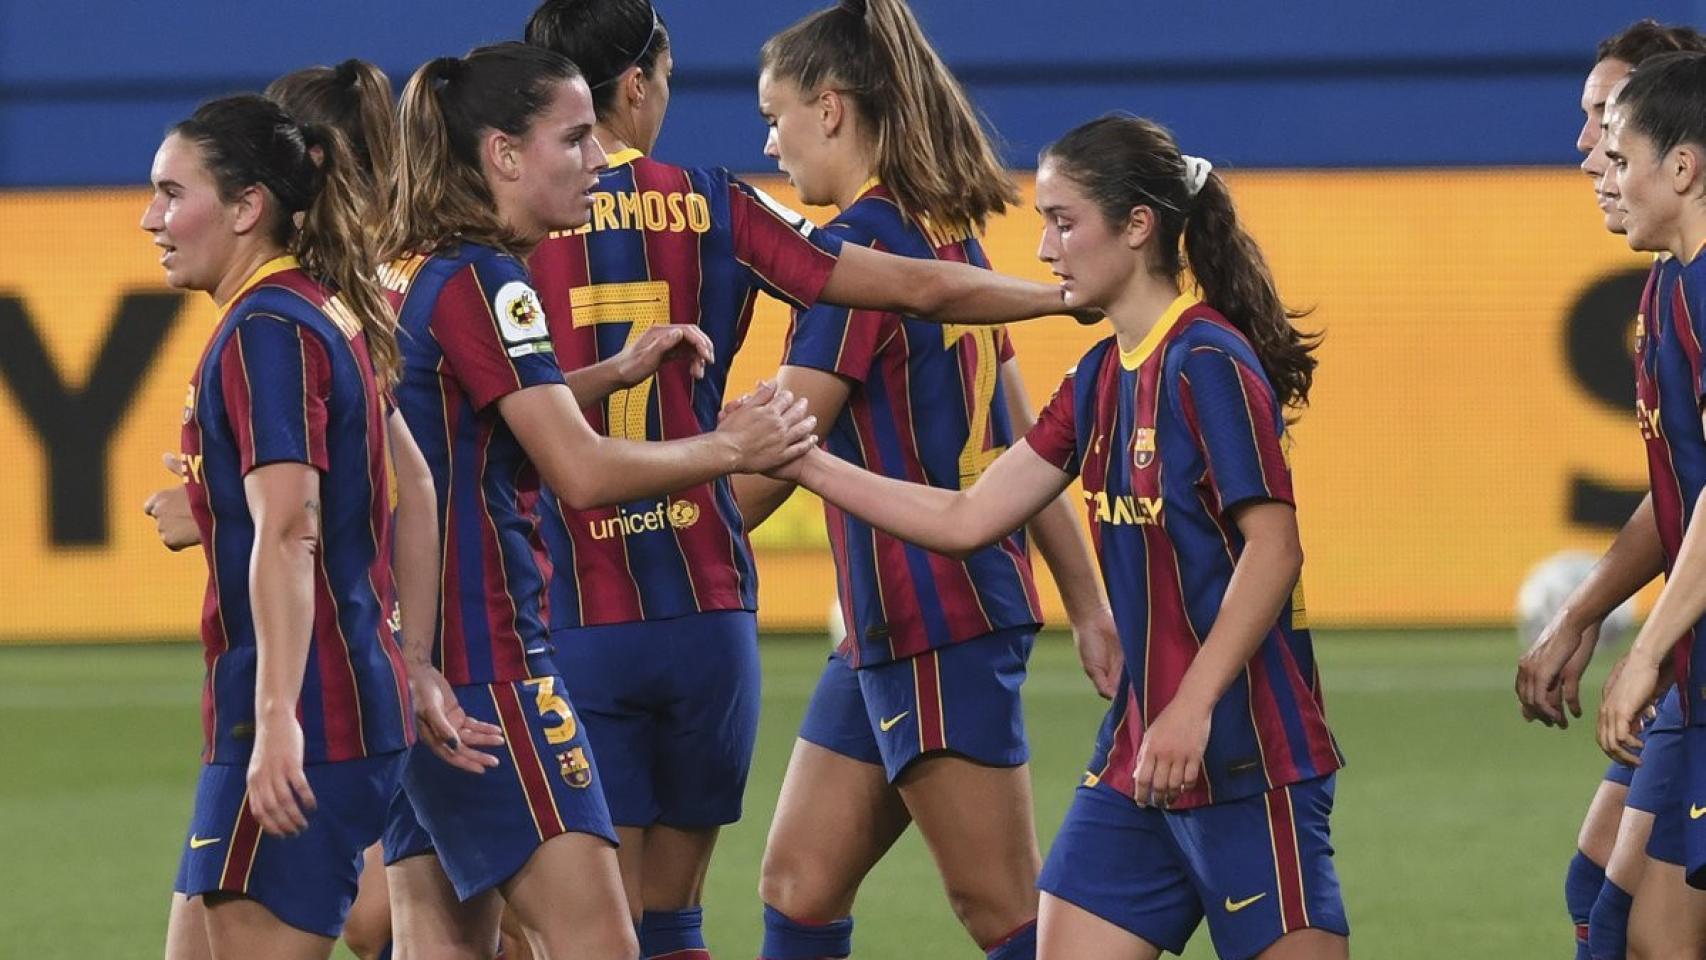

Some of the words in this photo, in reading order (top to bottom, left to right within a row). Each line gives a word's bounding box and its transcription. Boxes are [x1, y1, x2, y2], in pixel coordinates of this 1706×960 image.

[0, 288, 188, 548] Y
[569, 280, 670, 441] 7
[589, 502, 665, 540] unicef
[523, 676, 577, 745] 3
